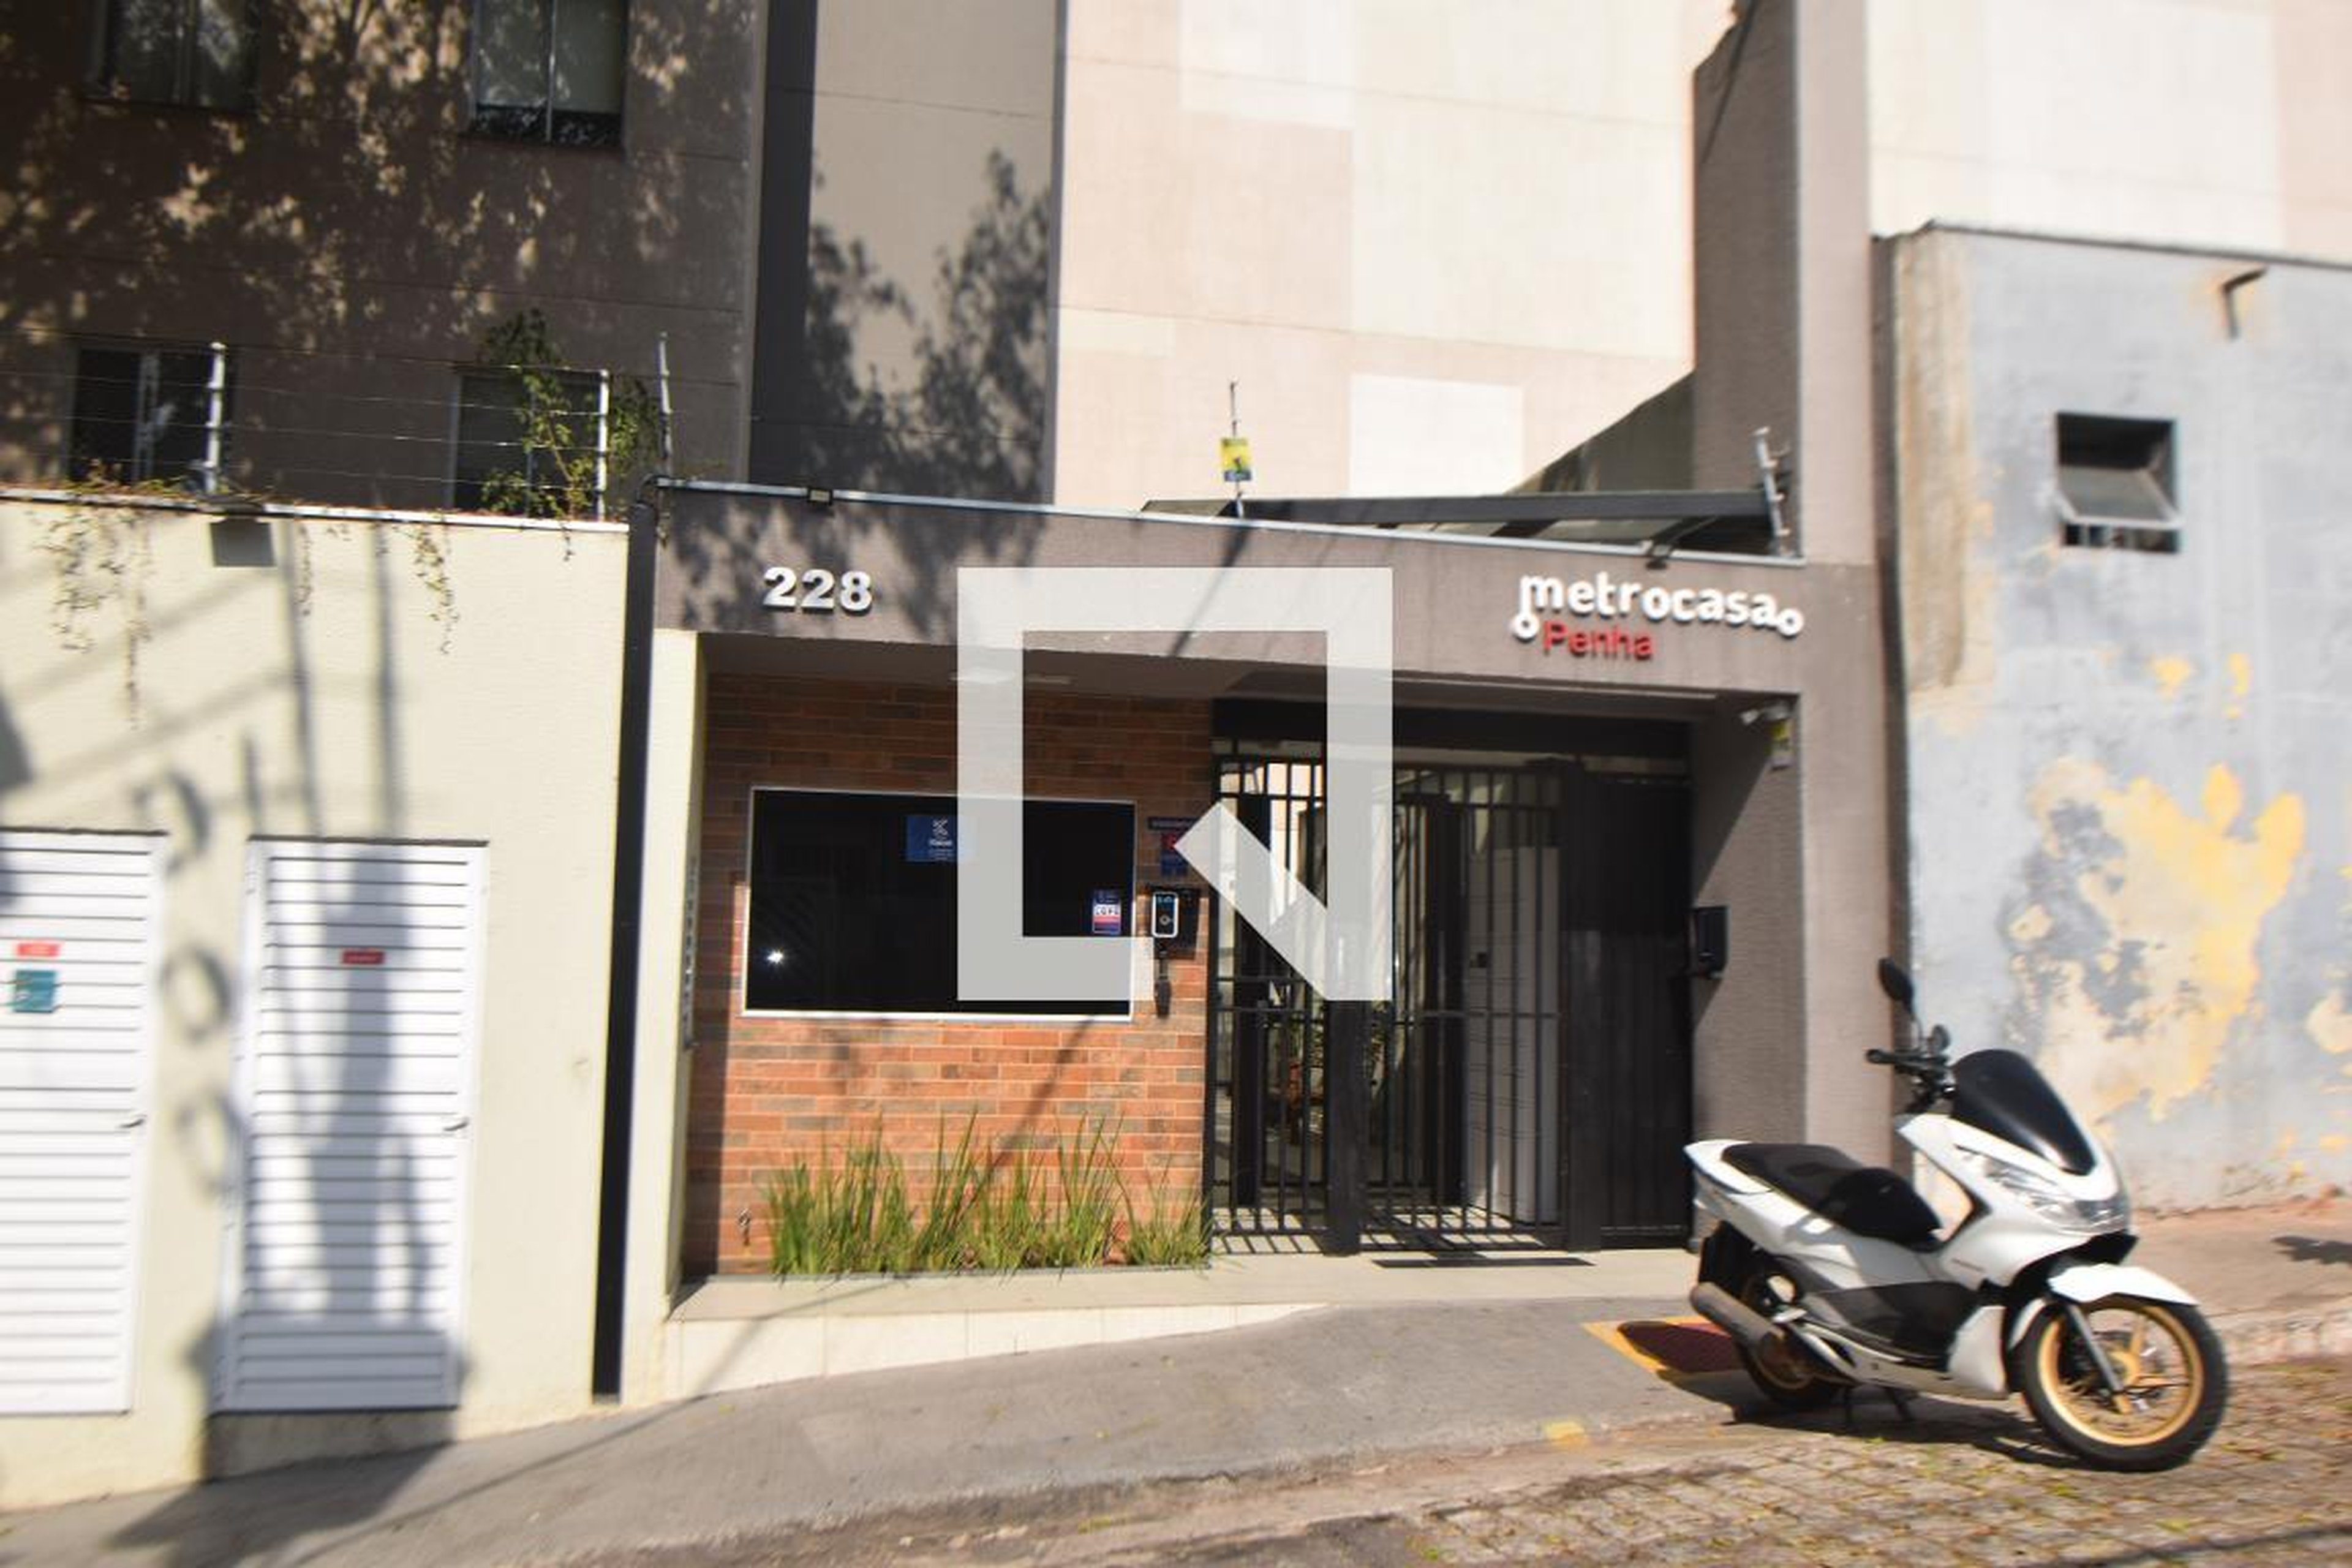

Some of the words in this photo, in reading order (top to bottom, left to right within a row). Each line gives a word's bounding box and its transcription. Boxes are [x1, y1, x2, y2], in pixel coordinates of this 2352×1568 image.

[763, 567, 873, 614] 228
[1512, 570, 1804, 639] metrocasa
[1542, 620, 1654, 658] Penha
